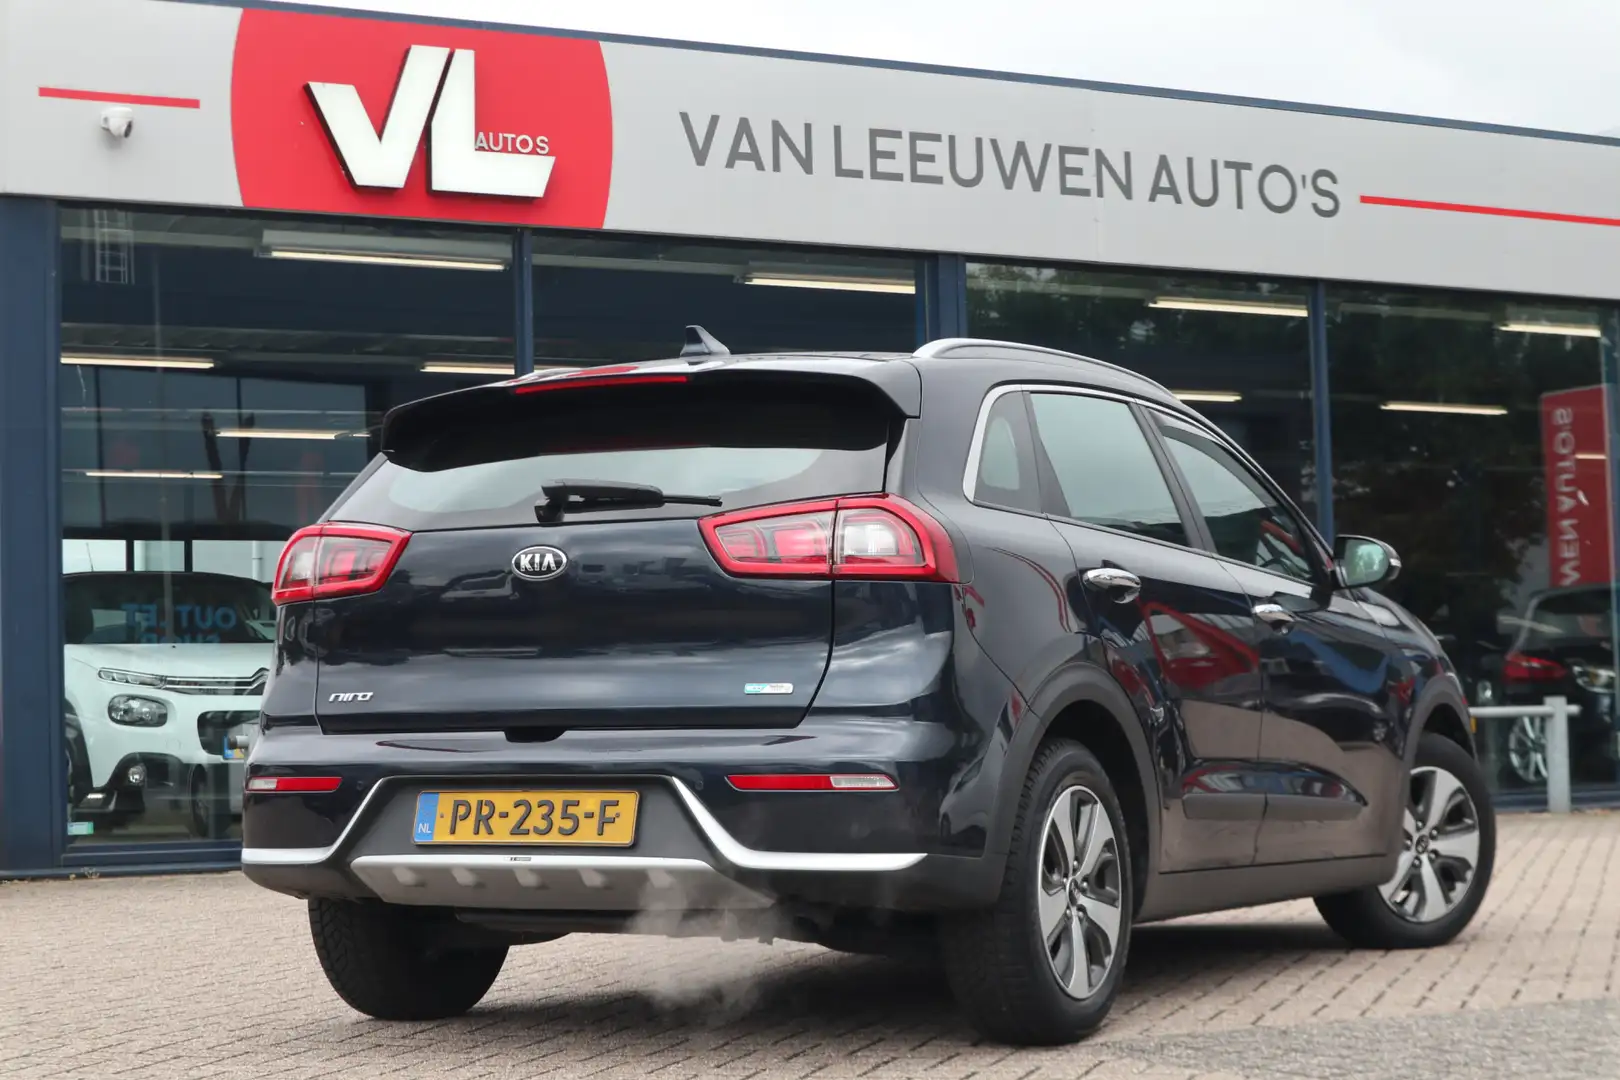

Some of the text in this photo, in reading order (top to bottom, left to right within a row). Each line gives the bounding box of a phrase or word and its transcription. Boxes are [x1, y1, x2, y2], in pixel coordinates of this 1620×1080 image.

[303, 44, 556, 201] VL
[475, 131, 549, 155] AUTOS
[679, 111, 1340, 218] VAN LEEUWEN AUTO'S
[520, 553, 557, 572] KIA
[418, 823, 432, 834] NL
[449, 799, 620, 836] PR-235-F
